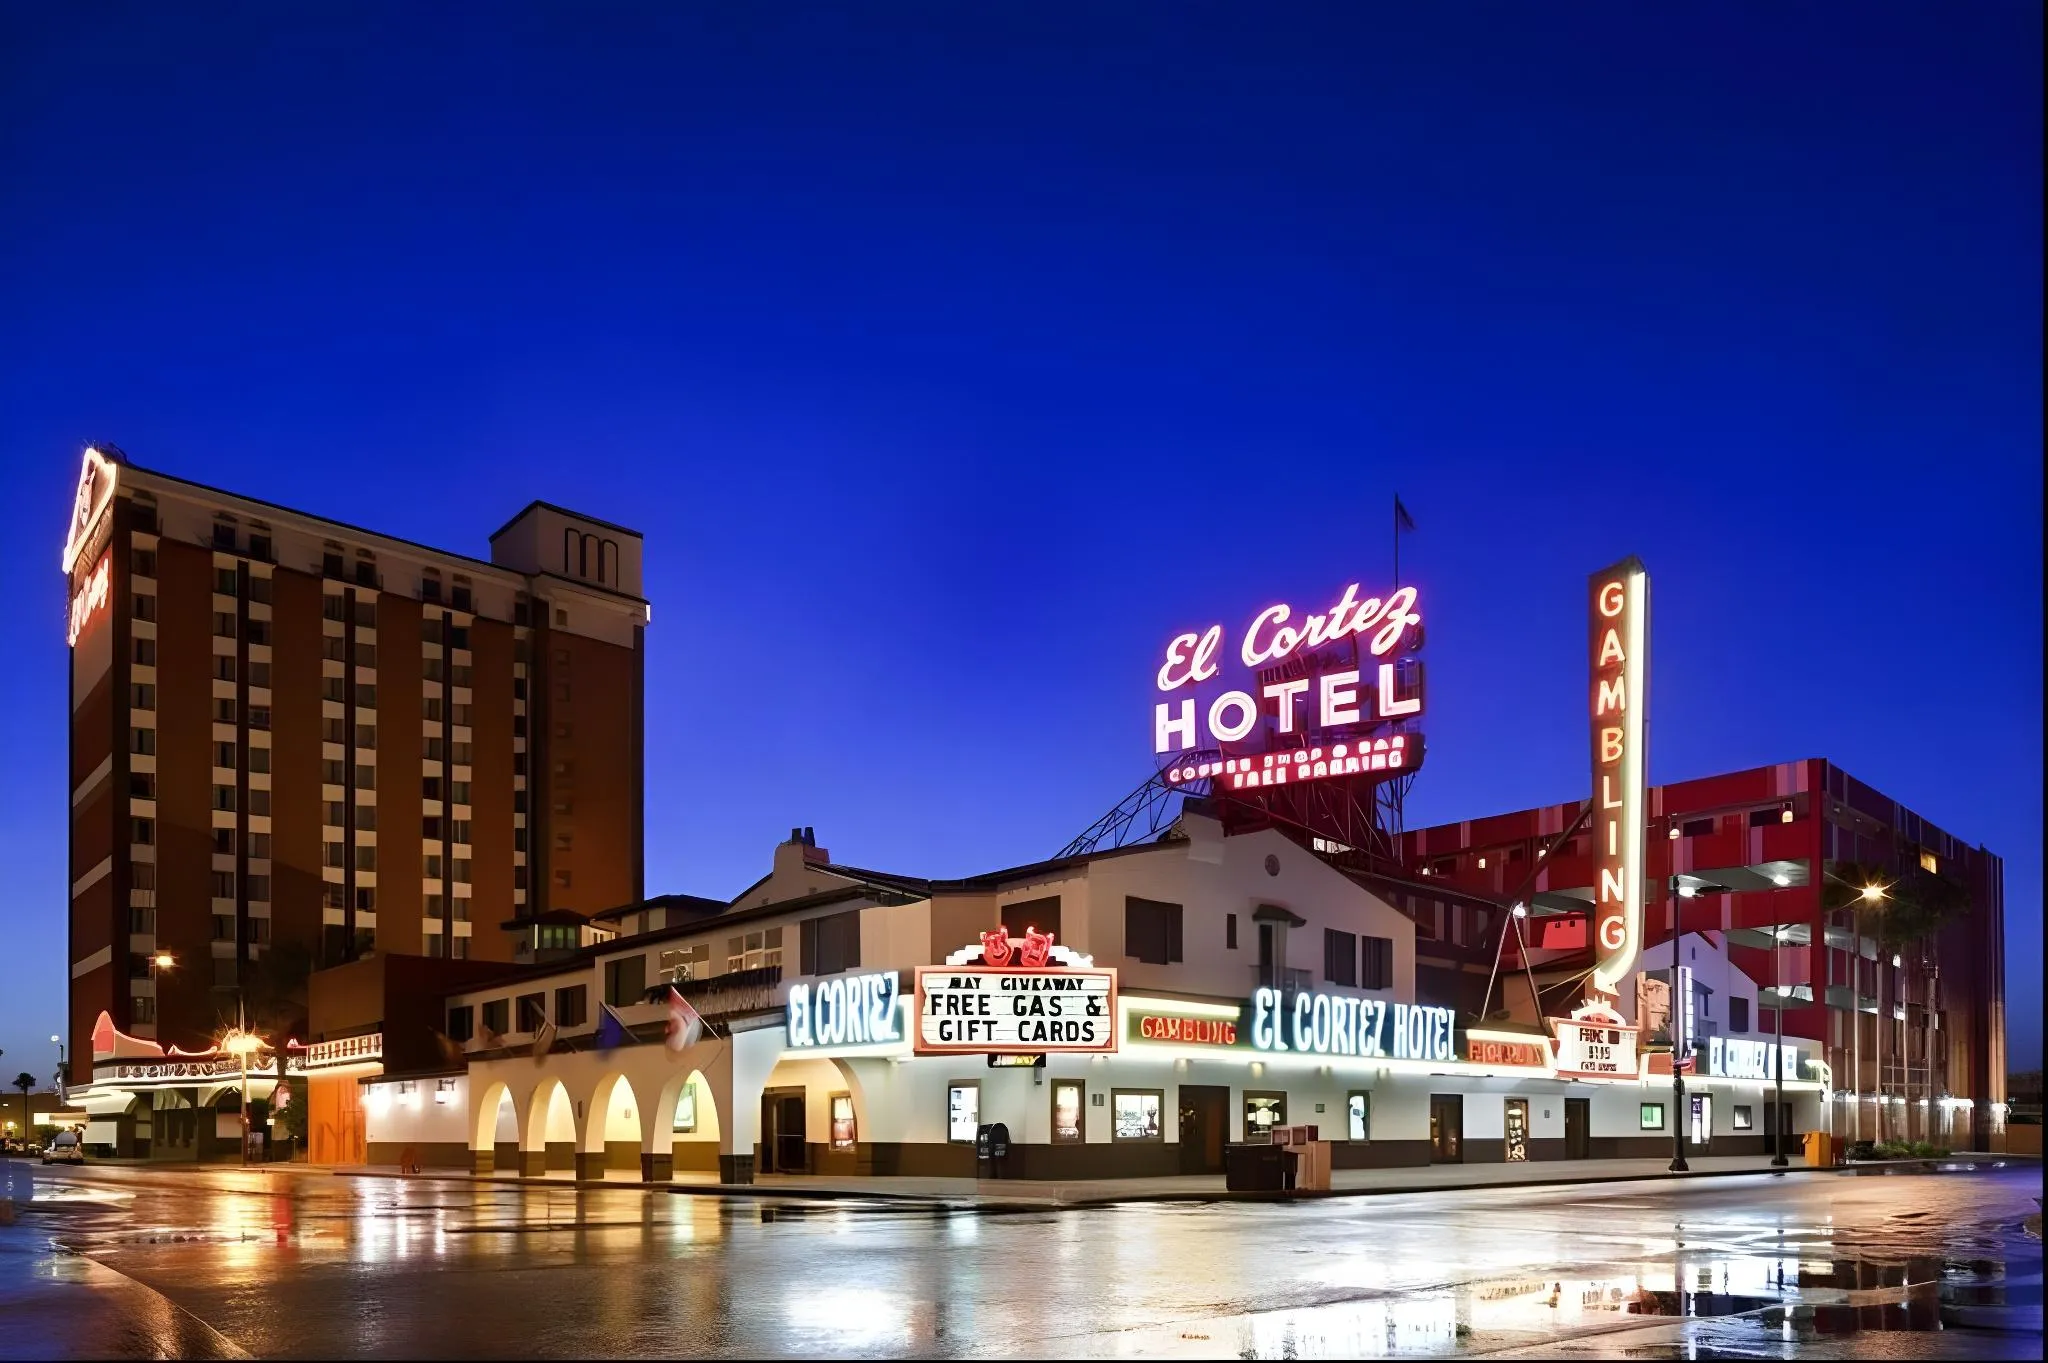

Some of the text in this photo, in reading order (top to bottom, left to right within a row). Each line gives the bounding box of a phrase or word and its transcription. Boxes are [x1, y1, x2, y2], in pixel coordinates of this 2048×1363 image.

[1157, 582, 1421, 692] El Cortez
[1155, 663, 1421, 753] HOTEL
[1597, 582, 1626, 950] GAMBLING
[789, 972, 899, 1047] EL CORTEZ
[931, 994, 1101, 1016] FREE GAS &
[939, 1020, 1095, 1042] GIFT CARDS
[1140, 1016, 1237, 1045] GAMBLING
[1255, 987, 1457, 1061] EL CORTEZ HOTEL
